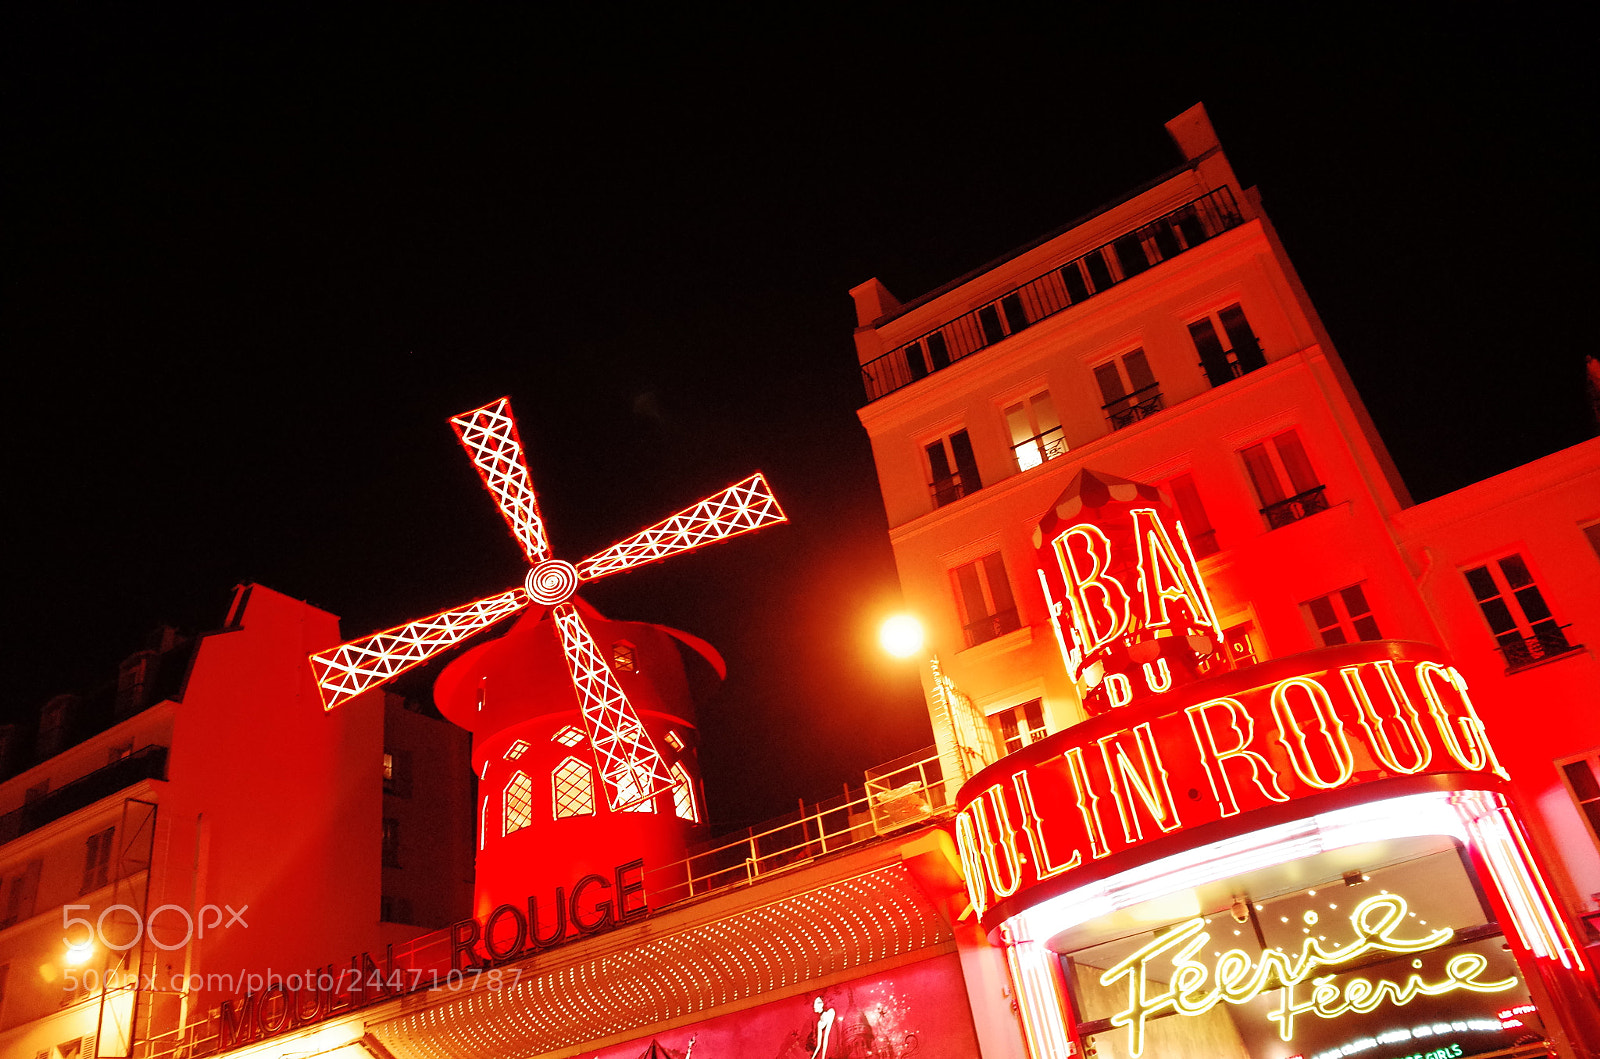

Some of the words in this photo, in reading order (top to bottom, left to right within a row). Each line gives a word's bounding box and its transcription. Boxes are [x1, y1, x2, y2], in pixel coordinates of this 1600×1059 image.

[1051, 508, 1224, 654] BA
[1104, 657, 1172, 708] DU
[1184, 660, 1511, 818] ROUG
[217, 943, 394, 1049] MOULIN
[450, 858, 648, 972] ROUGE
